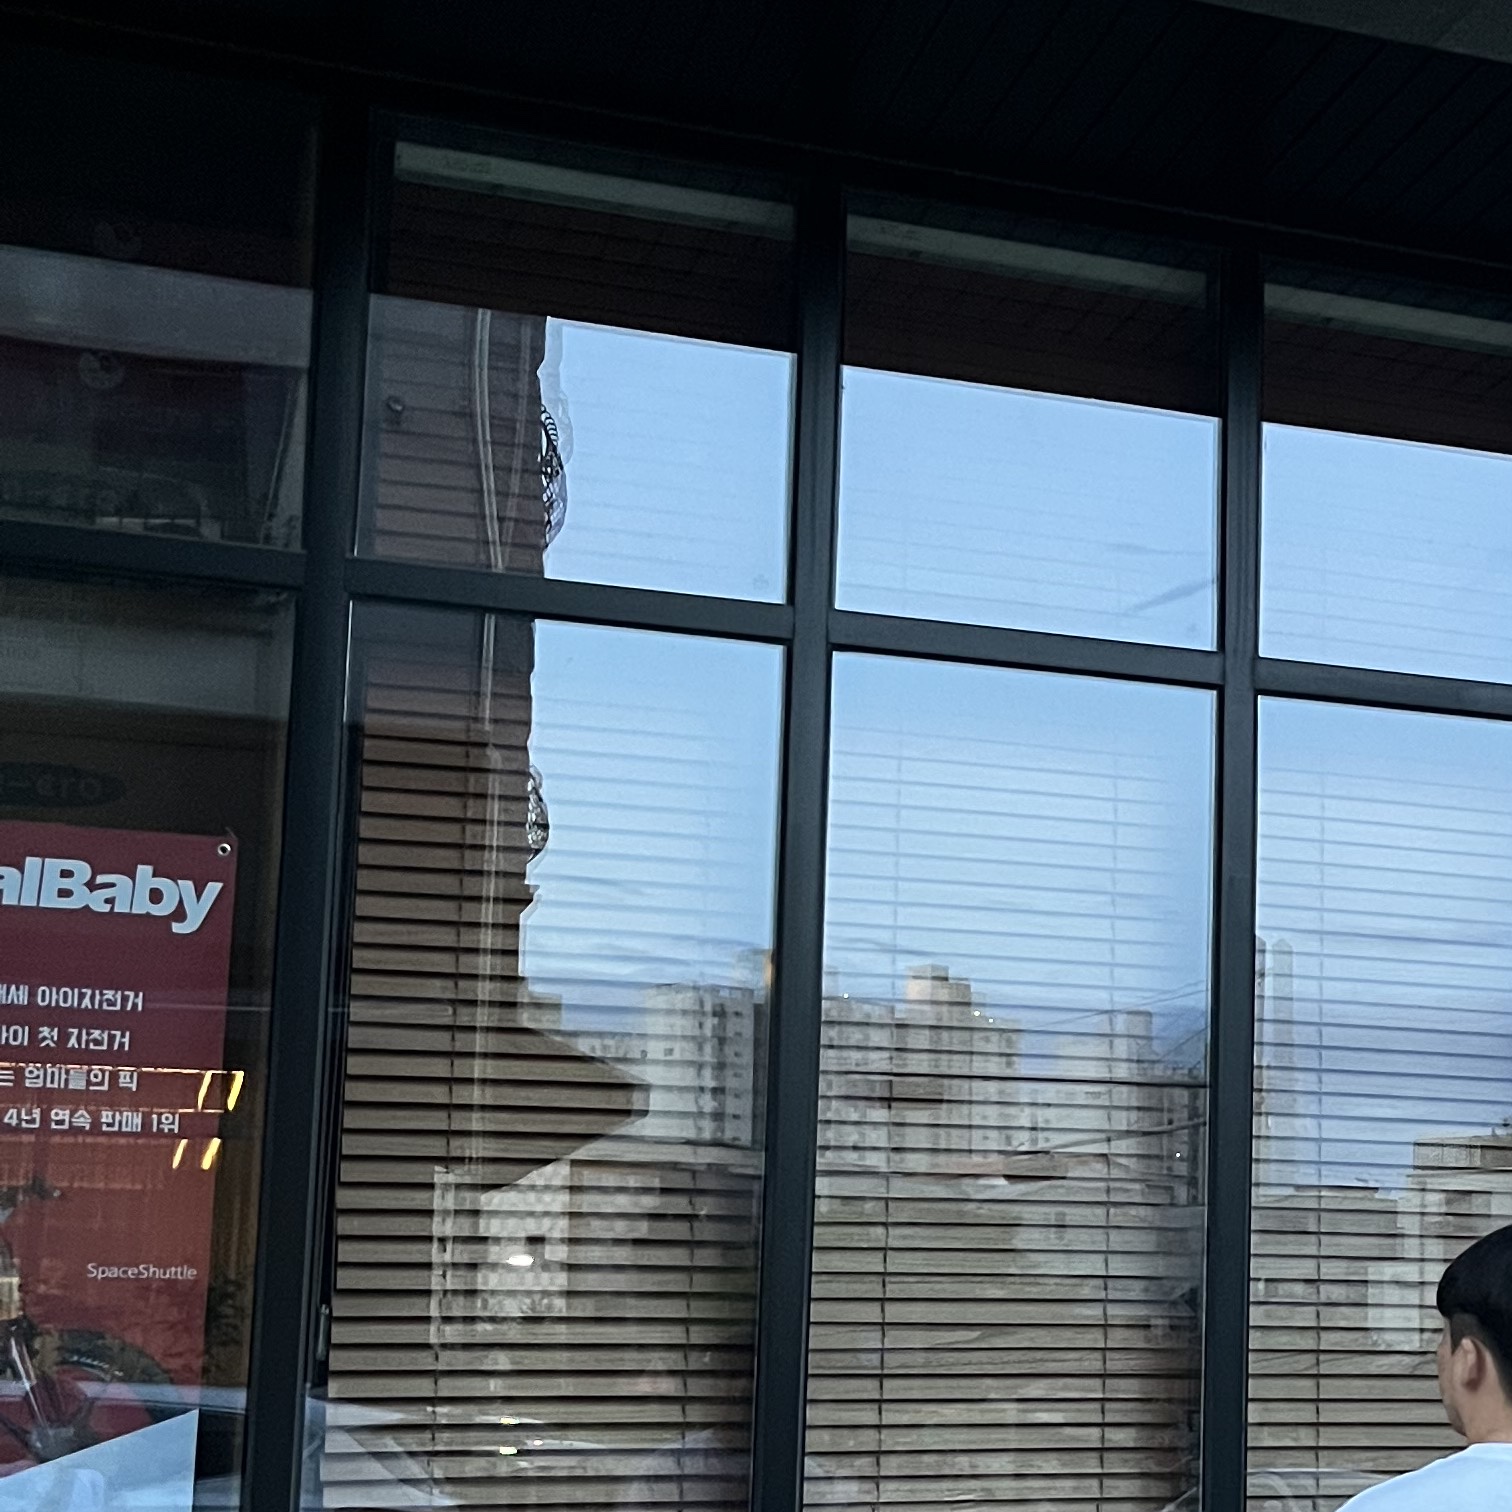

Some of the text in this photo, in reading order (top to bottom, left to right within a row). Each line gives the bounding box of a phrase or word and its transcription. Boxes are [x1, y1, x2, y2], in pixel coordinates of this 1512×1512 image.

[37, 986, 144, 1011] 아이자전거
[38, 1026, 58, 1047] 첫
[66, 1028, 130, 1051] 자전거
[25, 1066, 109, 1091] 엄마들의
[118, 1071, 138, 1091] 픽
[3, 1108, 180, 1133] 4년 연속 판매 1위
[87, 1263, 198, 1280] SpaceShuttle
